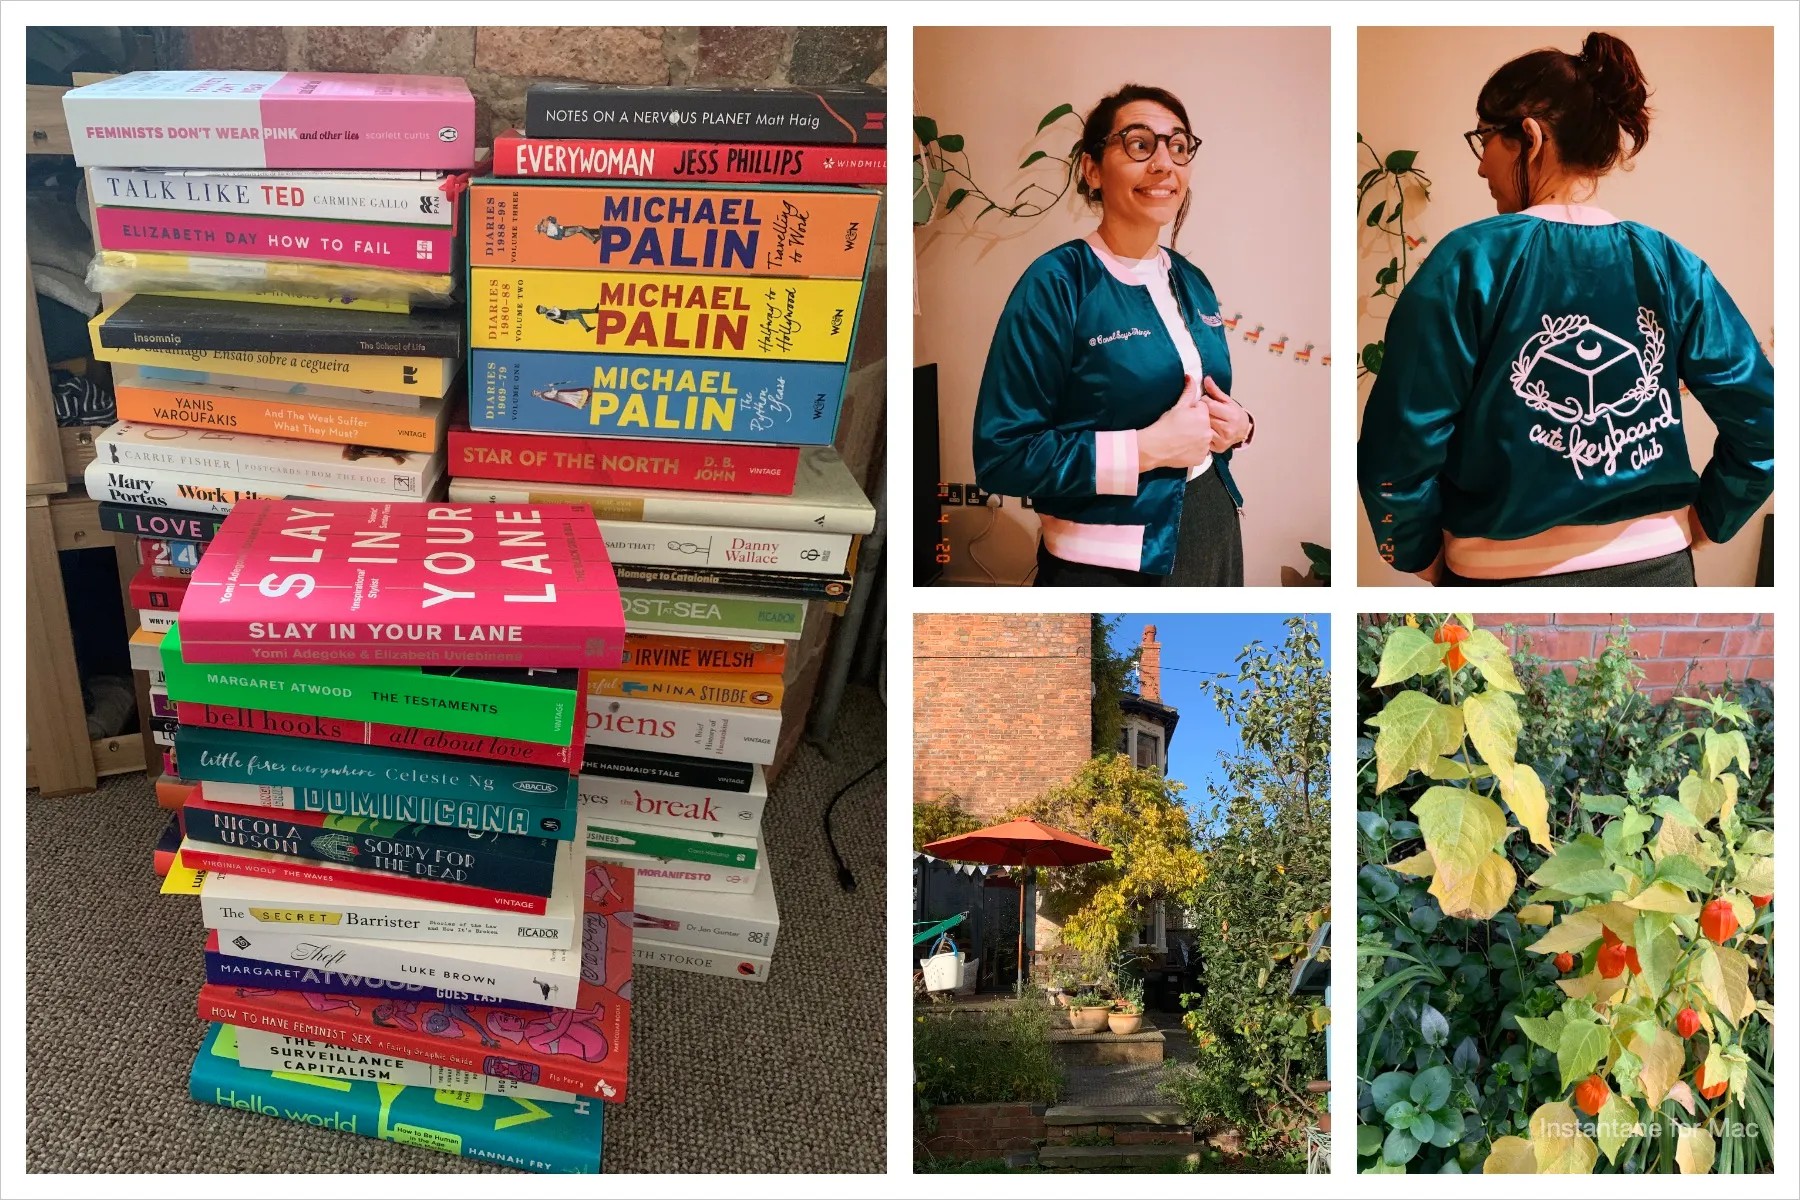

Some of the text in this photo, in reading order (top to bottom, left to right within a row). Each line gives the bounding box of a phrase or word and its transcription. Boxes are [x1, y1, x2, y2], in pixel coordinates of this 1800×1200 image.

[86, 127, 430, 140] FEMINISTS DON'T WEAR PINK and other lies scarlett curtis
[546, 110, 820, 130] NOTES ON A NERVOUS PLANET Matt Haig
[516, 144, 887, 176] EVERYWOMAN JESS PHILLIPS WINDMILL
[107, 177, 176, 200] TALK
[186, 182, 250, 204] LIKE
[261, 186, 304, 207] TED
[313, 195, 366, 207] CARMINE
[370, 197, 408, 209] GALLO
[604, 196, 761, 225] MICHAEL
[123, 224, 390, 254] ELIZABETH DAY HOW TO FAIL
[486, 197, 495, 256] DIARIES
[498, 201, 506, 253] 1988–98
[768, 200, 798, 269] Travelling
[789, 210, 809, 264] to Work
[599, 226, 759, 269] PALIN
[489, 279, 498, 340] DIARIES
[501, 284, 510, 336] 1980–88
[599, 282, 750, 310] MICHAEL
[596, 311, 749, 350] PALIN
[759, 288, 782, 352] Halfway to
[777, 288, 802, 352] Hollywood
[134, 333, 181, 344] Insomnia
[486, 362, 496, 420] DIARIES
[498, 367, 507, 416] 1969–79
[592, 367, 738, 394] MICHAEL
[175, 398, 214, 411] YANIS
[590, 392, 735, 432] PALIN
[740, 392, 752, 410] The
[751, 388, 773, 432] Python
[770, 376, 792, 422] Years
[153, 408, 237, 426] VAROUFAKIS
[1529, 424, 1566, 452] cute
[1563, 388, 1680, 480] keyboard
[125, 450, 231, 468] CARRIE FISHER
[463, 447, 679, 474] STAR OF THE NORTH
[1631, 437, 1663, 470] club
[108, 473, 154, 494] Mary
[108, 489, 167, 507] Portas
[259, 508, 334, 599] SLAY
[348, 532, 401, 563] IN
[422, 507, 475, 608] YOUR
[496, 510, 557, 602] LANE
[726, 550, 778, 564] Wallace
[732, 538, 780, 554] Danny
[618, 568, 658, 581] Homage
[671, 572, 719, 583] Catalonia
[249, 623, 523, 642] SLAY IN YOUR LANE
[635, 649, 754, 668] IRVINE WELSH
[207, 674, 498, 714] MARGARET ATWOOD THE TESTAMENTS
[653, 683, 748, 704] NINA STIBBE
[205, 704, 534, 758] bell hooks all about love
[200, 750, 552, 792] little fires everywhere Celeste Ng ABACUS
[583, 761, 680, 778] THE HANDMAID'S TALE
[304, 788, 530, 835] DOMINICANA
[634, 790, 721, 822] break
[214, 814, 302, 840] NICOLA
[222, 830, 298, 854] UPSON
[364, 839, 475, 869] SORRY FOR
[202, 860, 242, 870] VIRGINIA
[245, 865, 276, 874] WOOLF
[303, 873, 333, 882] WAVES
[372, 855, 467, 882] THE DEAD
[637, 868, 711, 881] MORANIFESTO
[220, 907, 420, 929] The SECRET Barrister
[518, 927, 558, 939] PICADOR
[290, 943, 347, 968] Theft
[660, 953, 713, 968] STOKOE
[402, 965, 496, 985] LUKE BROWN
[212, 1007, 372, 1045] HOW TO HAVE FEMINIST SEX
[270, 1046, 404, 1068] SURVEILLANCE
[284, 1060, 390, 1080] CAPITALISM
[216, 1087, 357, 1134] Hello world
[468, 1148, 552, 1170] HANNAH FRY
